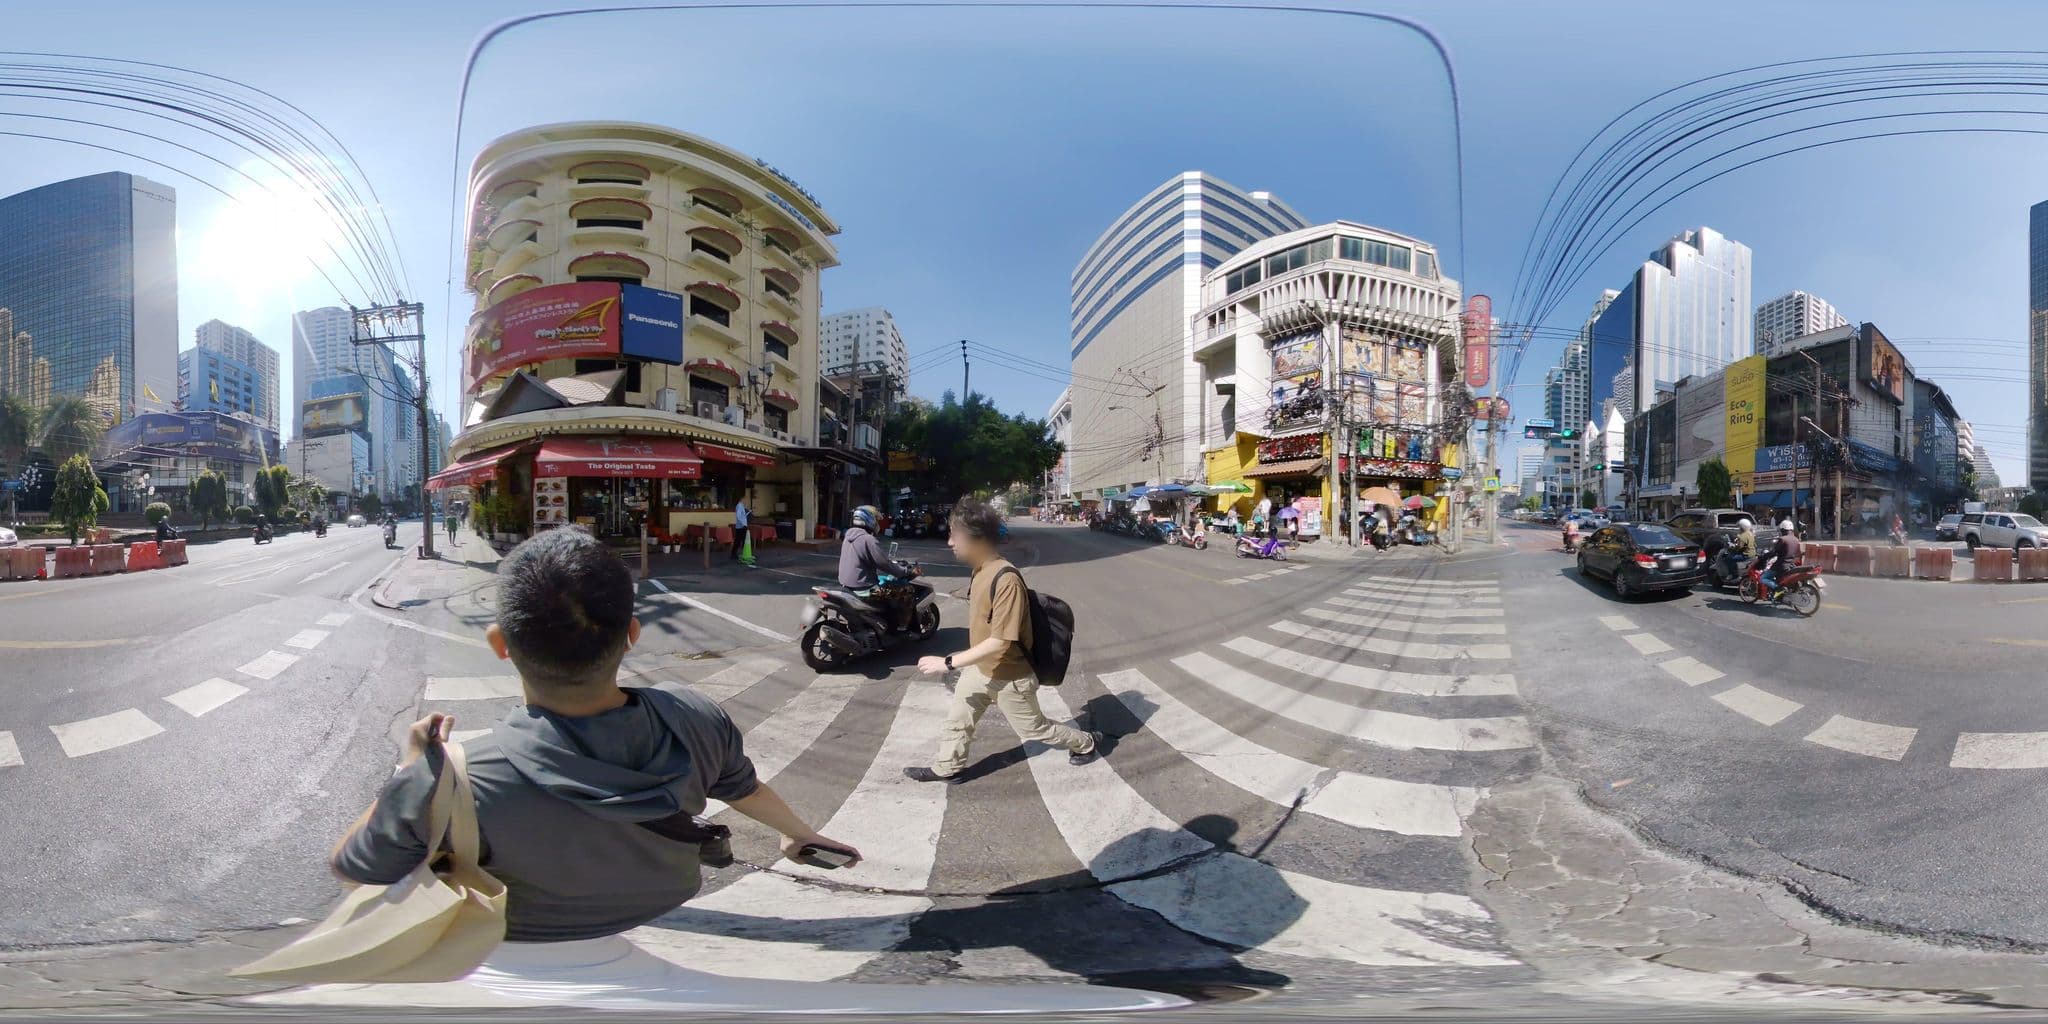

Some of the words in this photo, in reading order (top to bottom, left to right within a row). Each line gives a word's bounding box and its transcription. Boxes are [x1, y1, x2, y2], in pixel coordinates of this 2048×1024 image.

[628, 313, 679, 329] Panasonic
[1730, 400, 1747, 411] Eco
[1730, 412, 1754, 425] Ring
